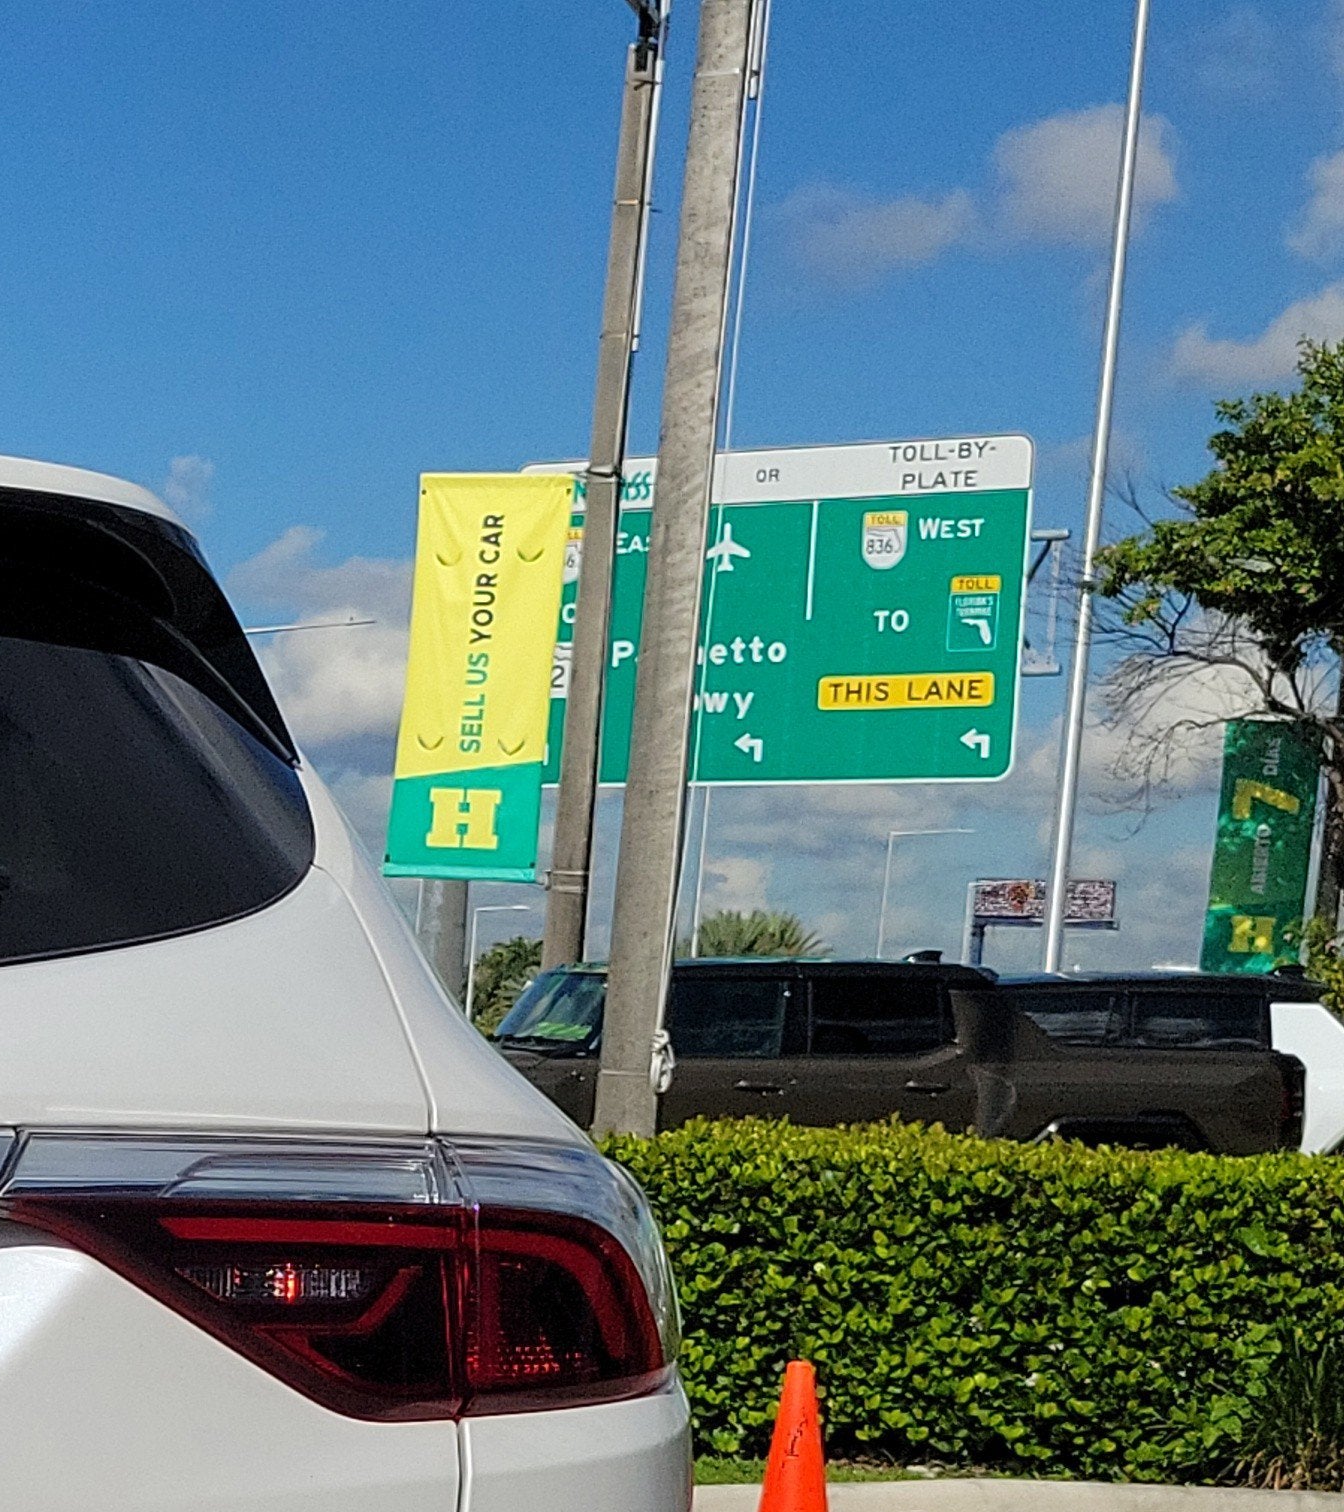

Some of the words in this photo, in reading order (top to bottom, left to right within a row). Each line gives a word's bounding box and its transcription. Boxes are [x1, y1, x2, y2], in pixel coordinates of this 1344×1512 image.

[888, 440, 997, 464] TOLL-BY-
[755, 468, 780, 483] OR
[901, 469, 978, 491] PLATE
[869, 514, 902, 526] TOLL
[918, 517, 985, 540] WEST
[479, 513, 505, 565] CAR
[865, 538, 894, 555] 836
[958, 578, 995, 590] TOLL
[469, 572, 499, 645] YOUR
[873, 609, 910, 633] TO
[466, 652, 490, 686] US
[828, 681, 890, 703] THIS
[906, 678, 985, 701] LANE
[459, 693, 486, 754] SELL
[1232, 778, 1300, 820] 7
[426, 787, 502, 850] H
